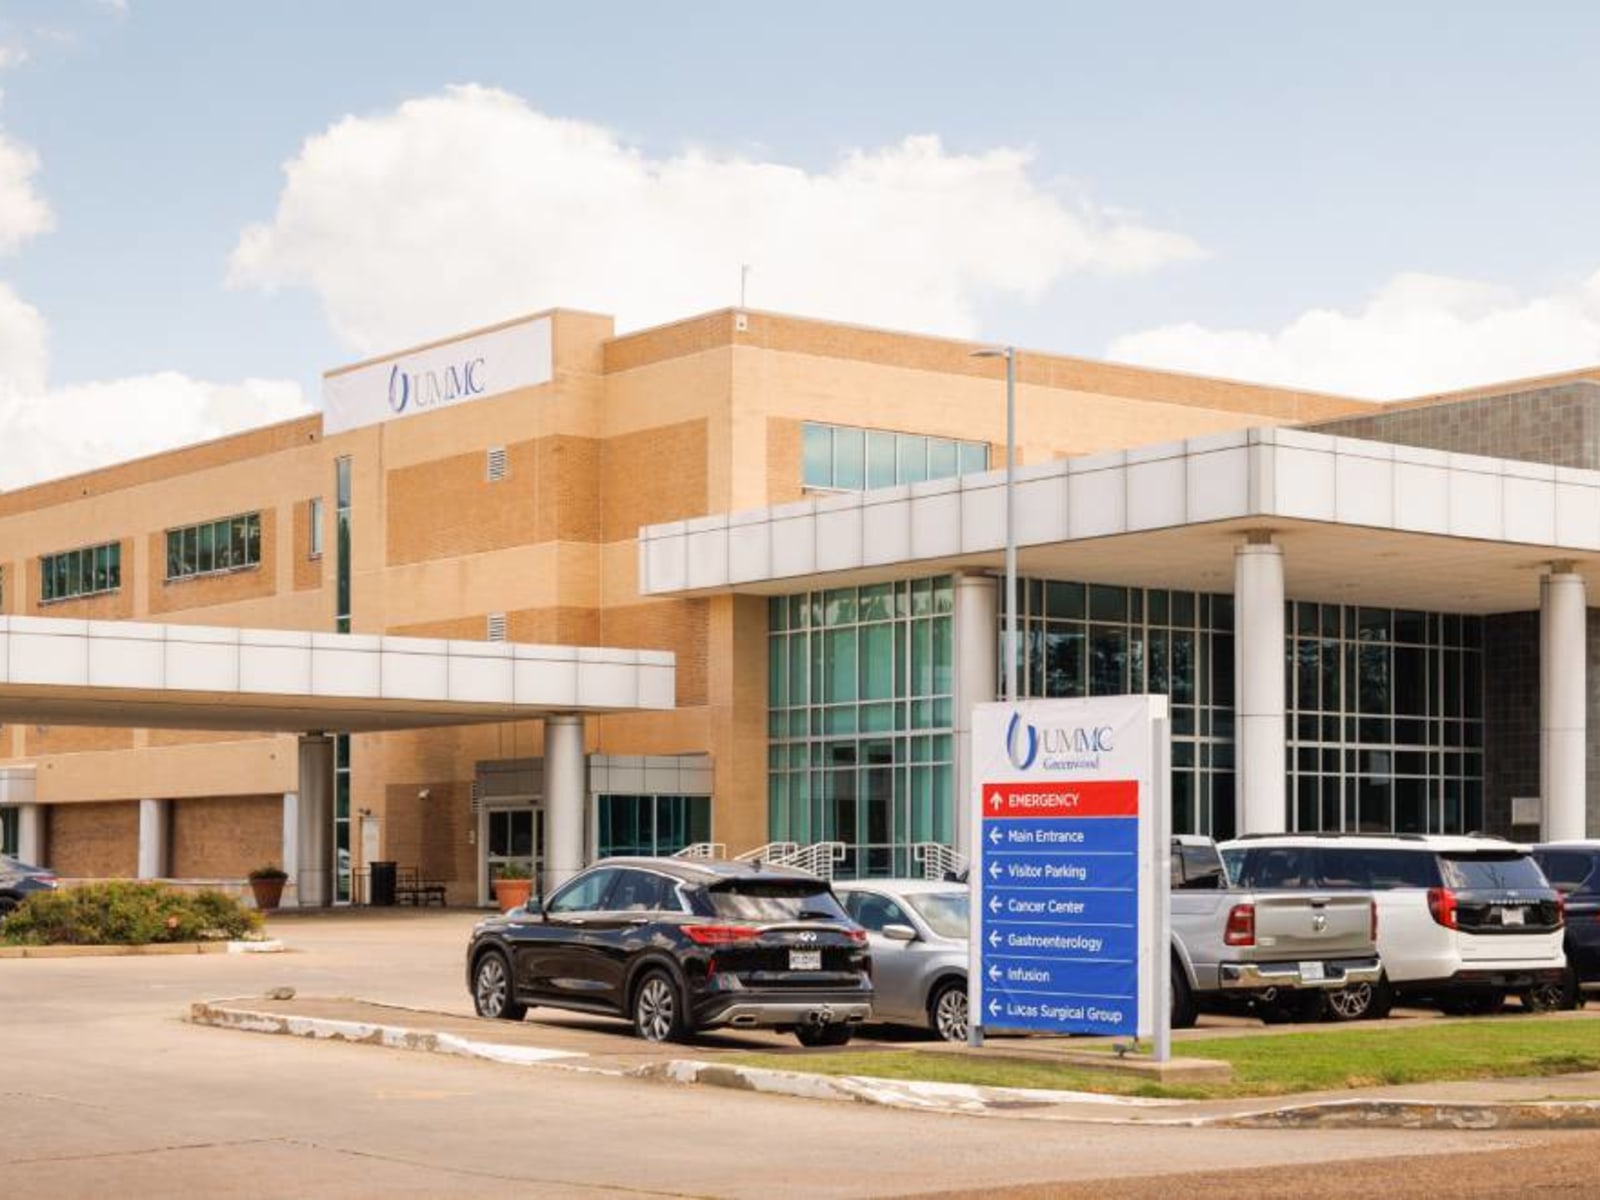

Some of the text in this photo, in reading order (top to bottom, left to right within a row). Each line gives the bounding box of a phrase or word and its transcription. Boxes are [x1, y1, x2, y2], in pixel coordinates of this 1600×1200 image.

[413, 358, 485, 406] UMMC
[1043, 727, 1114, 753] UMMC
[1043, 755, 1099, 770] Greenwood
[1008, 793, 1080, 808] EMERGENCY
[1008, 830, 1084, 843] Main Entrance
[1008, 865, 1086, 880] Visitor Parking
[1008, 899, 1084, 913] Cancer Center
[1008, 933, 1103, 951] Gastroenterology
[1008, 967, 1050, 982] Infusion
[1007, 1003, 1122, 1022] Lucas Surgical Group
